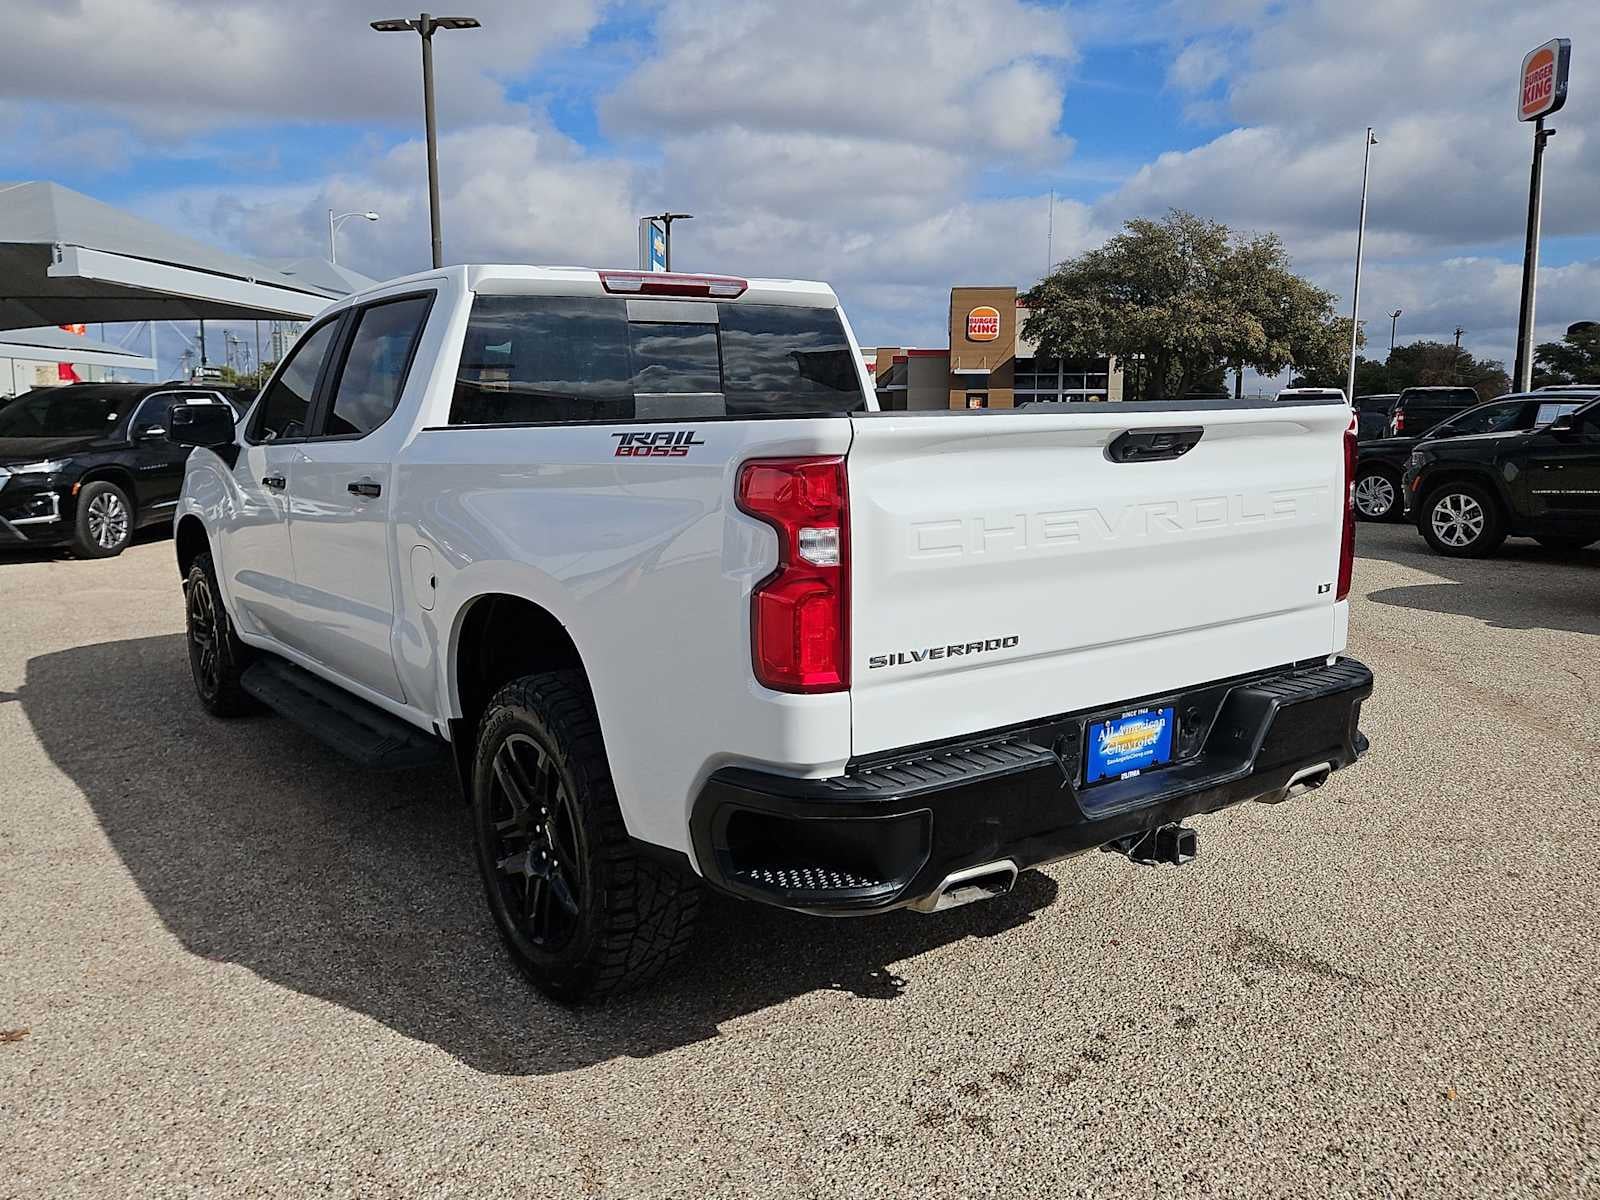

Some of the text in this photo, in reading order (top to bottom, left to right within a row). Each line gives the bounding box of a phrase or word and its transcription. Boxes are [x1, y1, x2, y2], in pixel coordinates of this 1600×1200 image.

[1524, 63, 1553, 89] BURGER
[1523, 77, 1552, 106] KING
[970, 325, 997, 333] KING
[611, 431, 705, 446] TRAIL
[614, 445, 690, 457] BOSS
[908, 485, 1330, 560] CHEVROLET
[1317, 582, 1333, 595] LT
[868, 635, 1019, 669] SILVERADO
[1097, 718, 1166, 742] All American
[1105, 734, 1158, 755] Chevrolet
